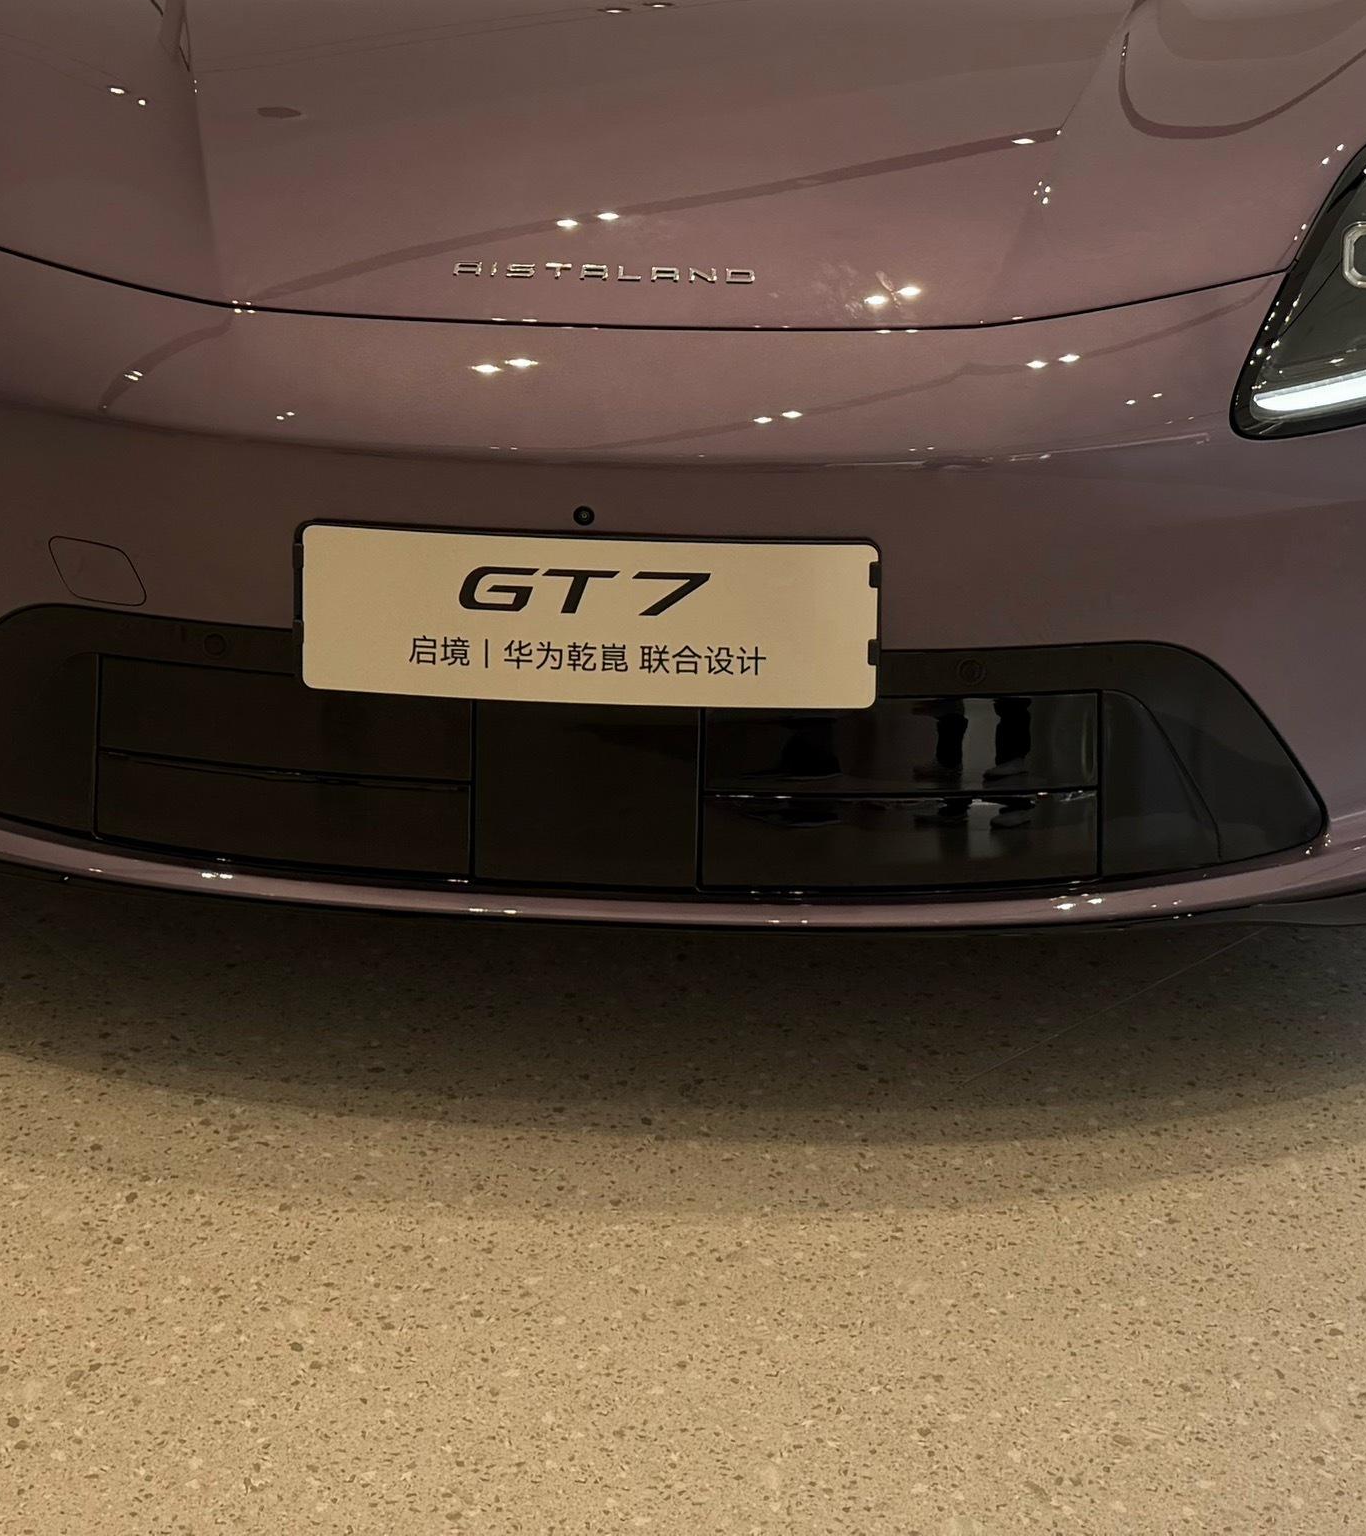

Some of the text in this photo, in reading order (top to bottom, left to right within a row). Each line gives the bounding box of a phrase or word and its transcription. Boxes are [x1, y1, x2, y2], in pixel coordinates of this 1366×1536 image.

[452, 260, 756, 284] AISTALAND
[409, 636, 767, 677] 启境 华为乾崑 联合设计
